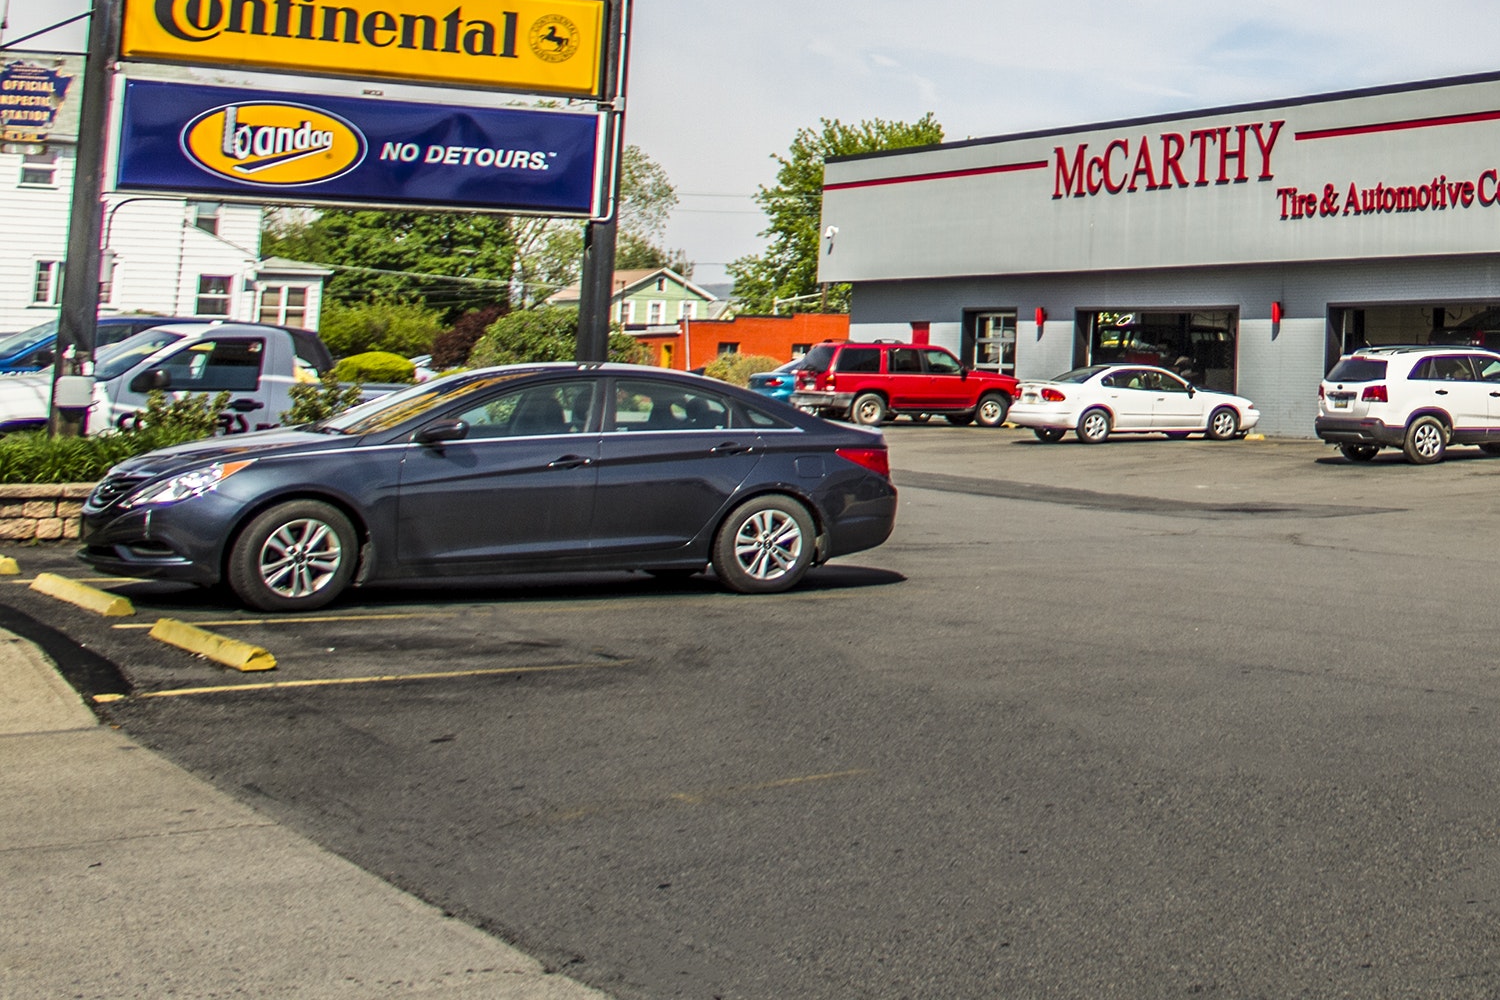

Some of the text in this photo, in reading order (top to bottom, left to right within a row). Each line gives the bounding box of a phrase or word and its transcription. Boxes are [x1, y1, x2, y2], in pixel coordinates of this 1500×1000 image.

[2, 80, 56, 92] OFFICIAL
[0, 109, 51, 121] STATION
[380, 142, 419, 162] NO
[1052, 120, 1285, 199] McCARTHY
[1277, 186, 1318, 220] Tire
[1319, 183, 1340, 217] &
[1342, 175, 1476, 216] Automotive
